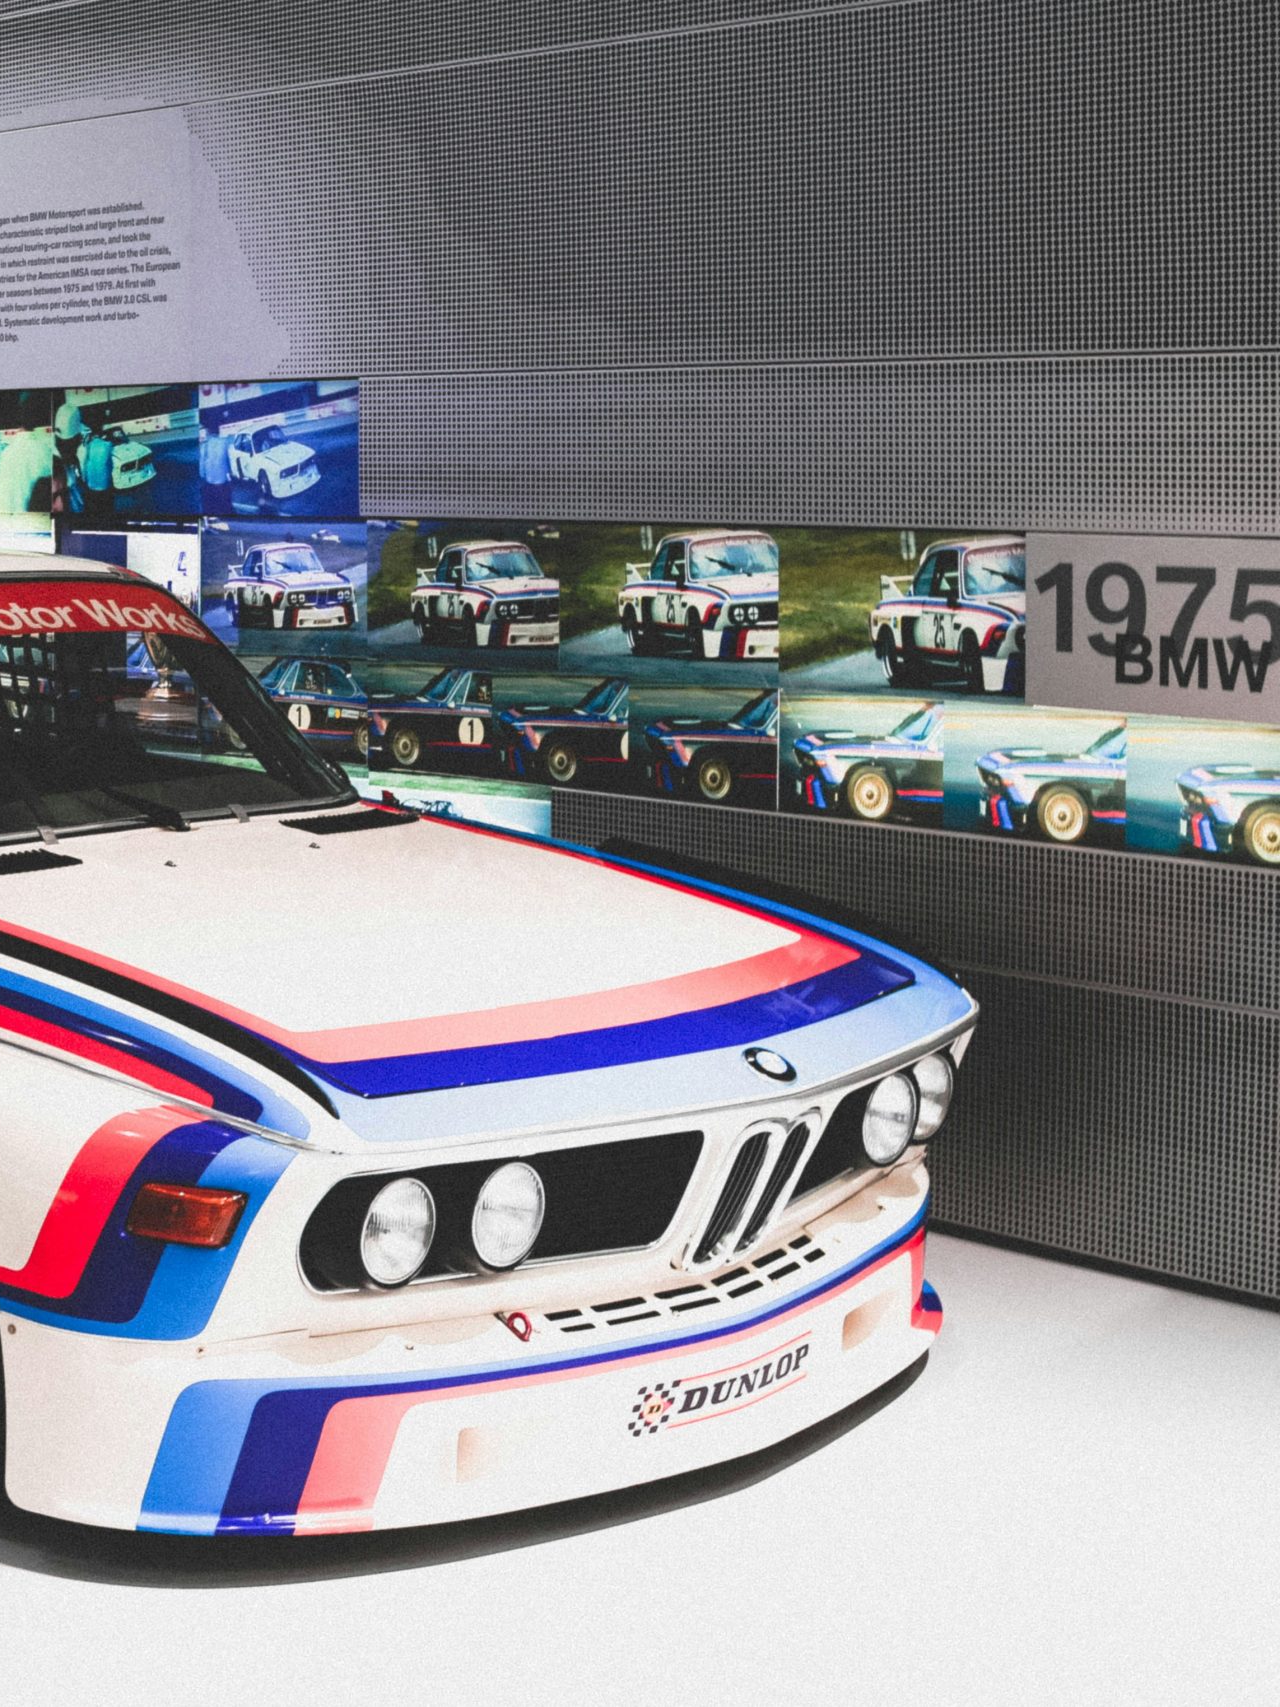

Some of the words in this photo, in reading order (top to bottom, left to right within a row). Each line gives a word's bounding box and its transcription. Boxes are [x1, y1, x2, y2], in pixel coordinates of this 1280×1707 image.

[72, 599, 206, 639] Works
[1034, 561, 1280, 664] 1975
[1116, 632, 1272, 693] BMW
[295, 706, 302, 728] 1
[467, 718, 475, 743] 1
[677, 1343, 810, 1414] DUNLOP
